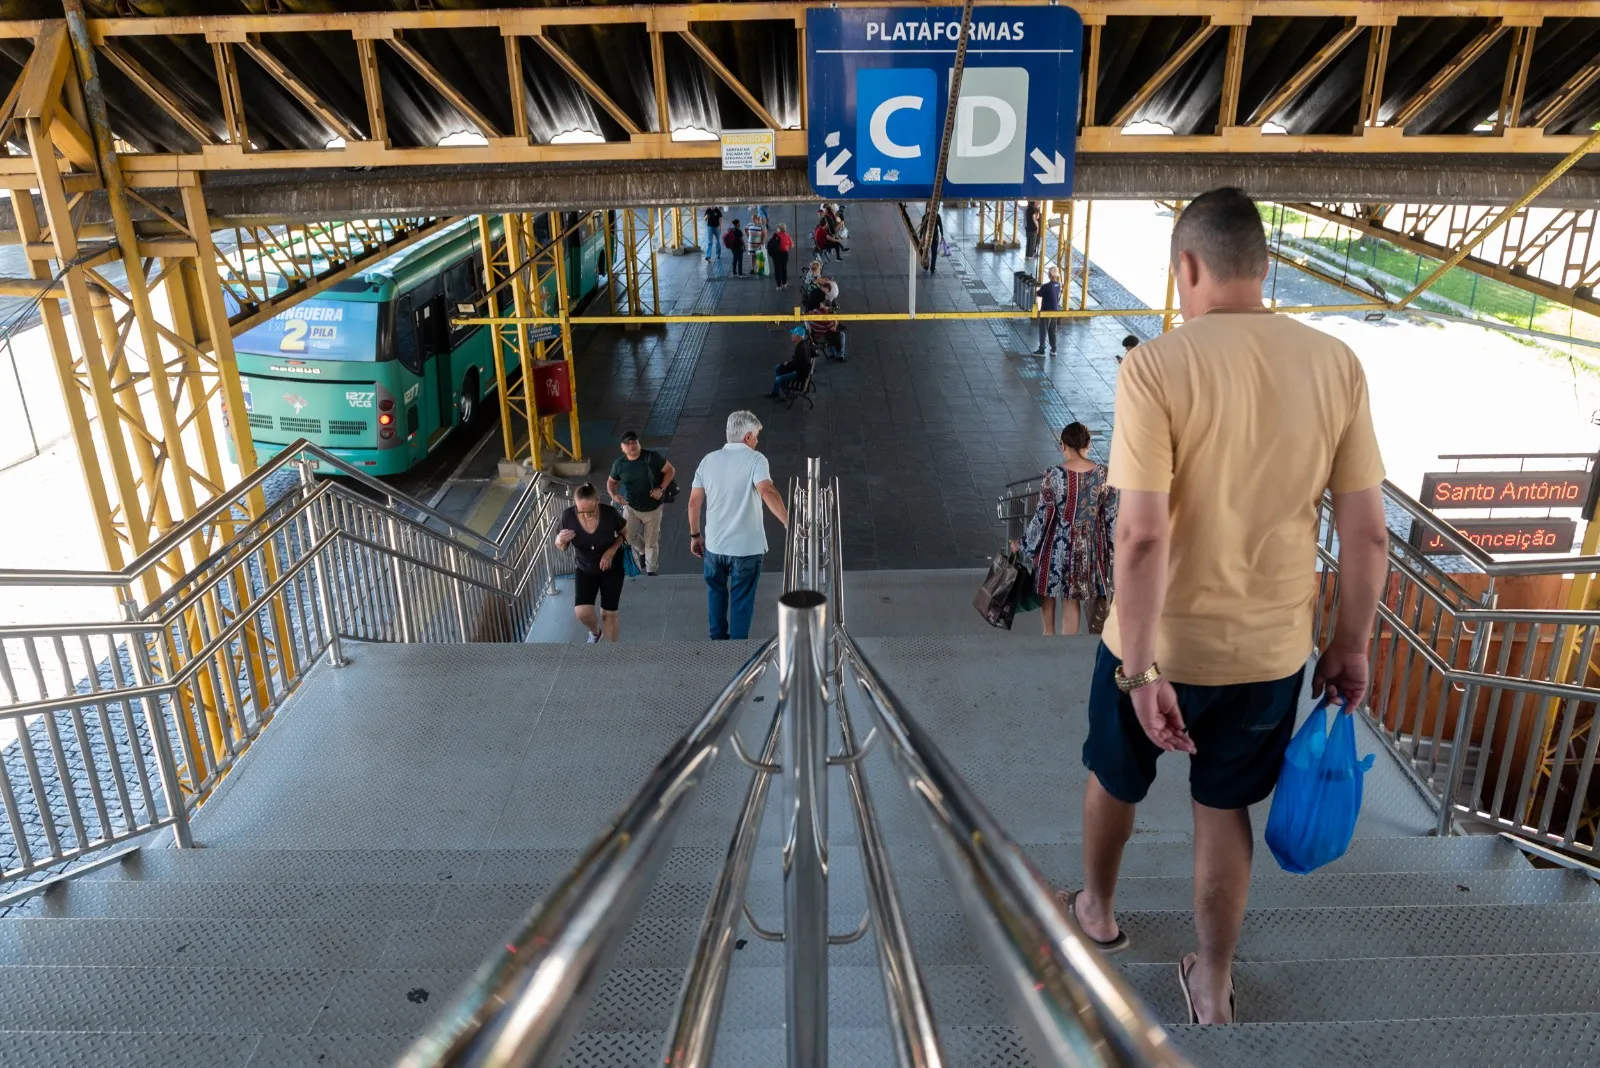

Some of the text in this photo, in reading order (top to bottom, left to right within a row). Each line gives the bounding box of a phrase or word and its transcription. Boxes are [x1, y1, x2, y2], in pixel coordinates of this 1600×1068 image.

[866, 21, 1025, 41] PLATAFORMAS
[869, 95, 1017, 159] C D
[280, 319, 308, 351] 2
[312, 328, 334, 338] PILA
[345, 391, 375, 401] 1277
[349, 400, 372, 408] VCG
[1435, 481, 1579, 501] Santo Antônio
[1429, 534, 1444, 547] J.
